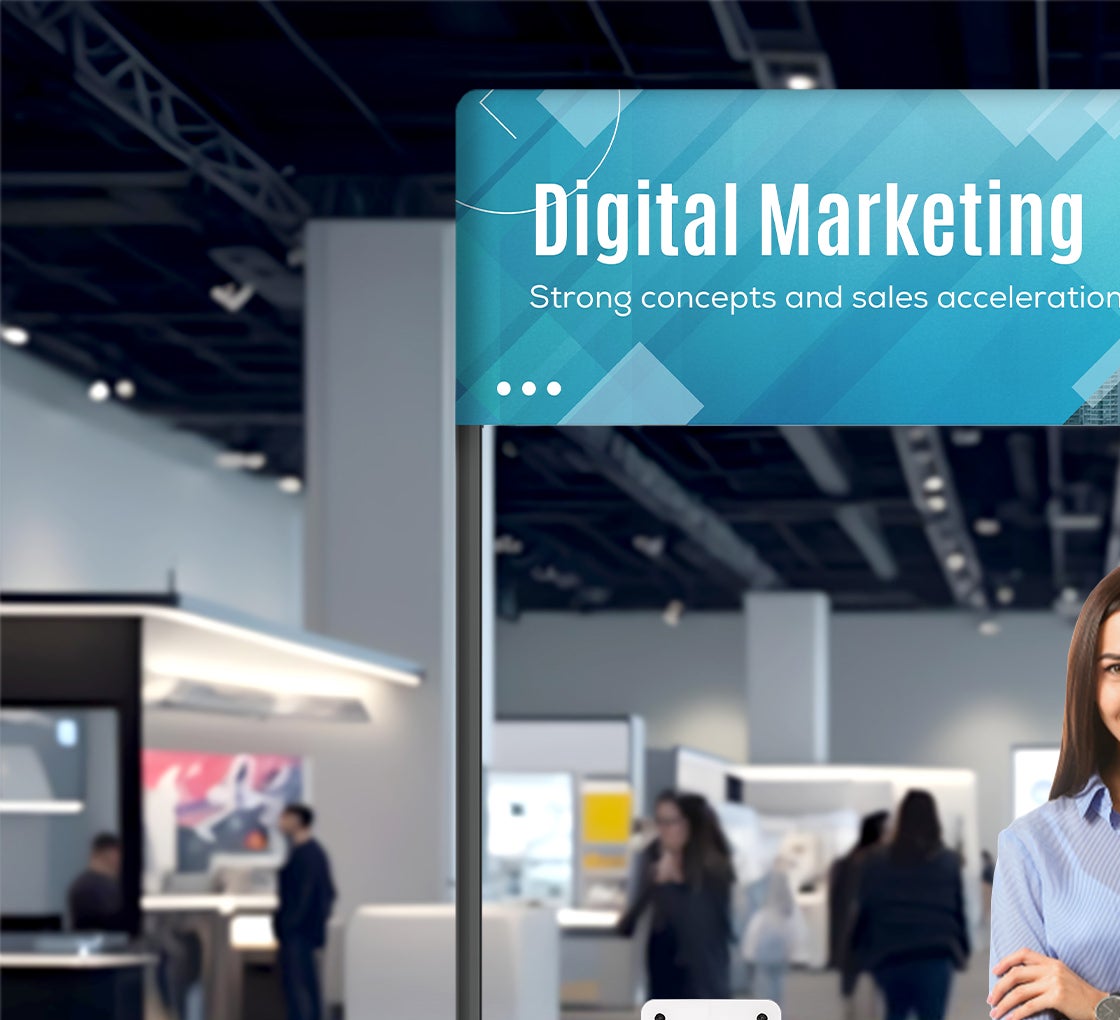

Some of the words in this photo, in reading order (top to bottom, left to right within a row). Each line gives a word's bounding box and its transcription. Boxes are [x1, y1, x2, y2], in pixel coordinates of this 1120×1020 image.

[533, 179, 737, 265] Digital
[761, 179, 1083, 265] Marketing
[530, 284, 632, 317] Strong
[641, 284, 777, 316] concepts
[785, 284, 842, 309] and
[852, 284, 928, 309] sales
